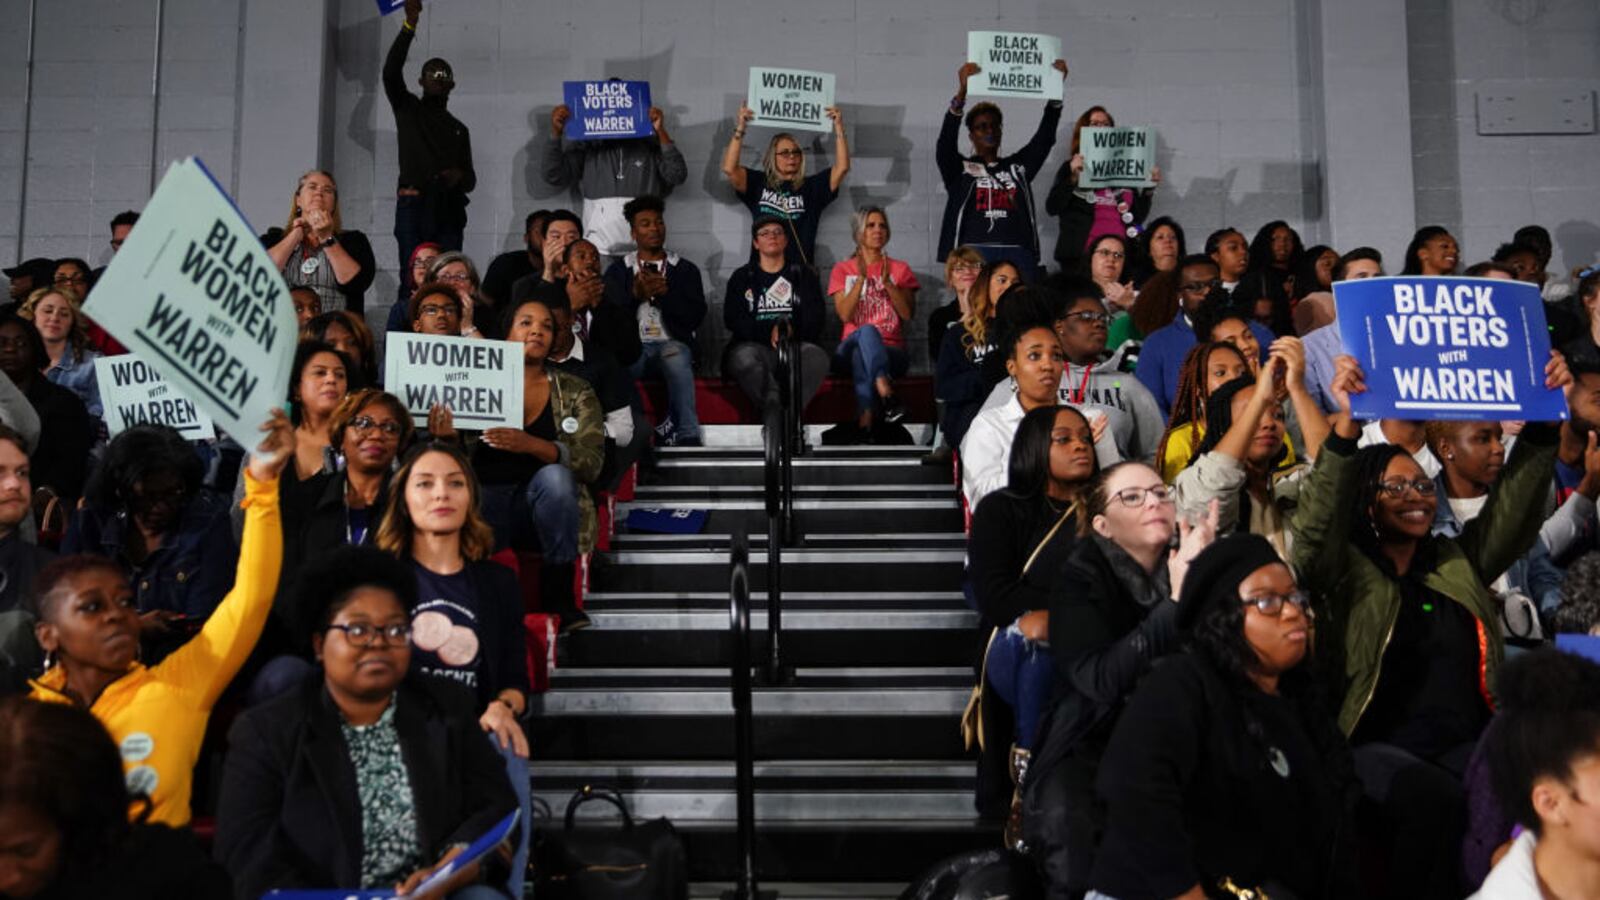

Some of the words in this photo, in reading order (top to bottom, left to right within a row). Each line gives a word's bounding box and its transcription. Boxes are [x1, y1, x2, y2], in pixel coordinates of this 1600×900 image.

[994, 35, 1039, 50] BLACK
[989, 49, 1043, 65] WOMEN
[585, 82, 628, 96] BLACK
[762, 72, 823, 92] WOMEN
[988, 72, 1042, 88] WARREN
[582, 95, 633, 109] VOTERS
[760, 98, 821, 120] WARREN
[584, 116, 634, 130] WARREN
[1093, 131, 1146, 148] WOMEN
[1092, 159, 1145, 176] WARREN
[205, 218, 281, 315] BLACK
[180, 240, 278, 353] WOMEN
[1393, 283, 1496, 316] BLACK
[206, 313, 236, 338] WITH
[1385, 314, 1509, 348] VOTERS
[146, 292, 259, 408] WARREN
[407, 340, 504, 370] WOMEN
[1438, 349, 1468, 365] WITH
[445, 371, 469, 382] WITH
[1392, 366, 1516, 402] WARREN
[148, 384, 168, 398] WITH
[405, 383, 503, 414] WARREN
[118, 398, 198, 431] WARREN
